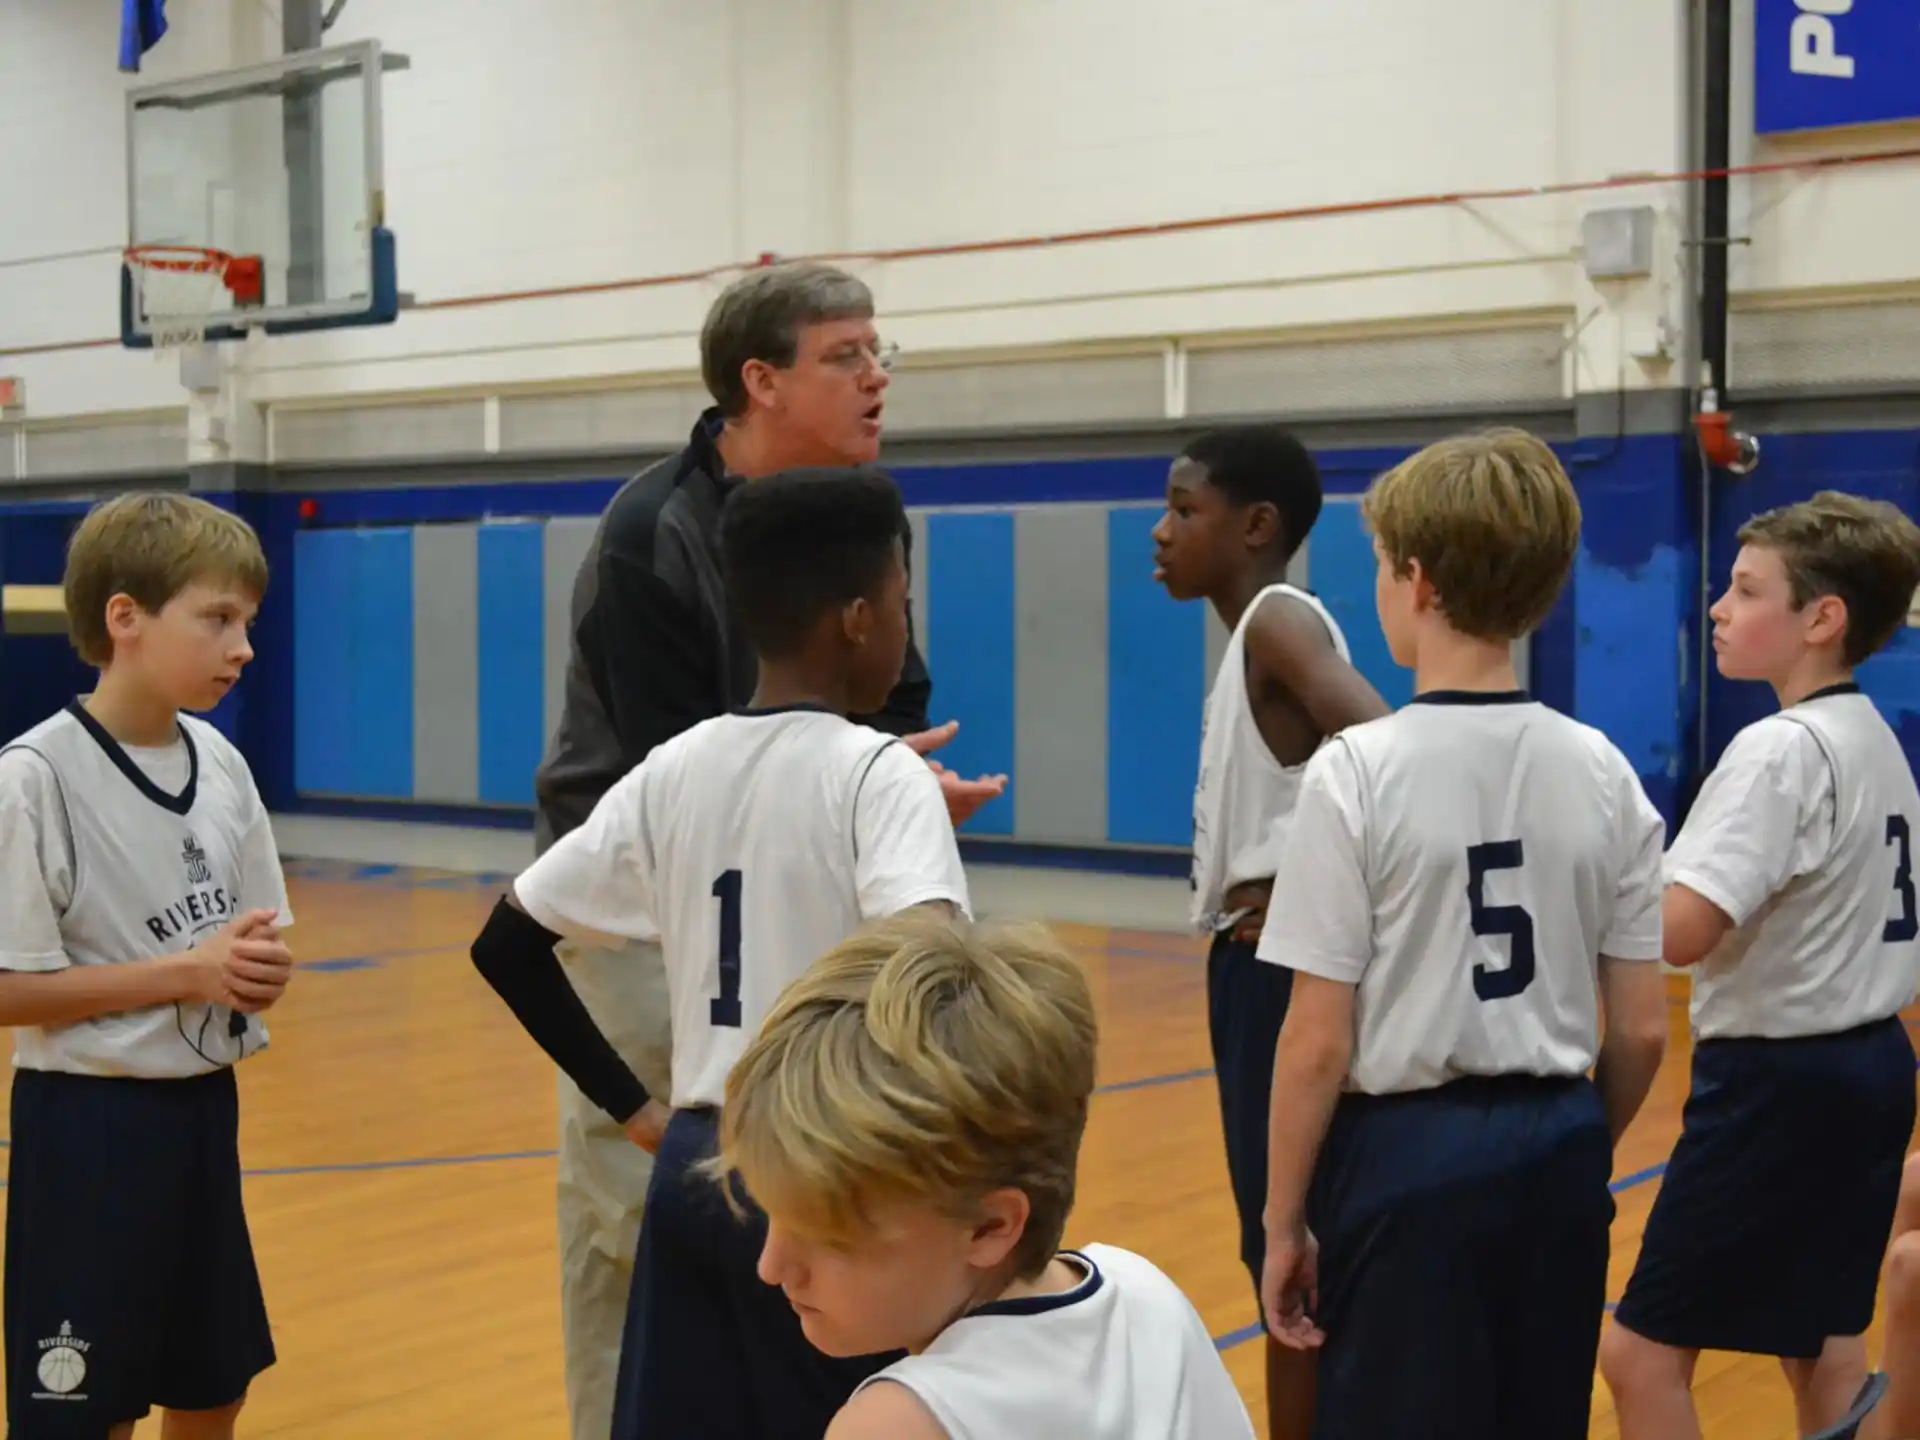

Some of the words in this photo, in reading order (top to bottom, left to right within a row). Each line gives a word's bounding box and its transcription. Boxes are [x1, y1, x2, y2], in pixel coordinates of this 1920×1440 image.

[710, 869, 742, 1028] 1
[1466, 839, 1535, 1002] 5
[1882, 814, 1919, 942] 3
